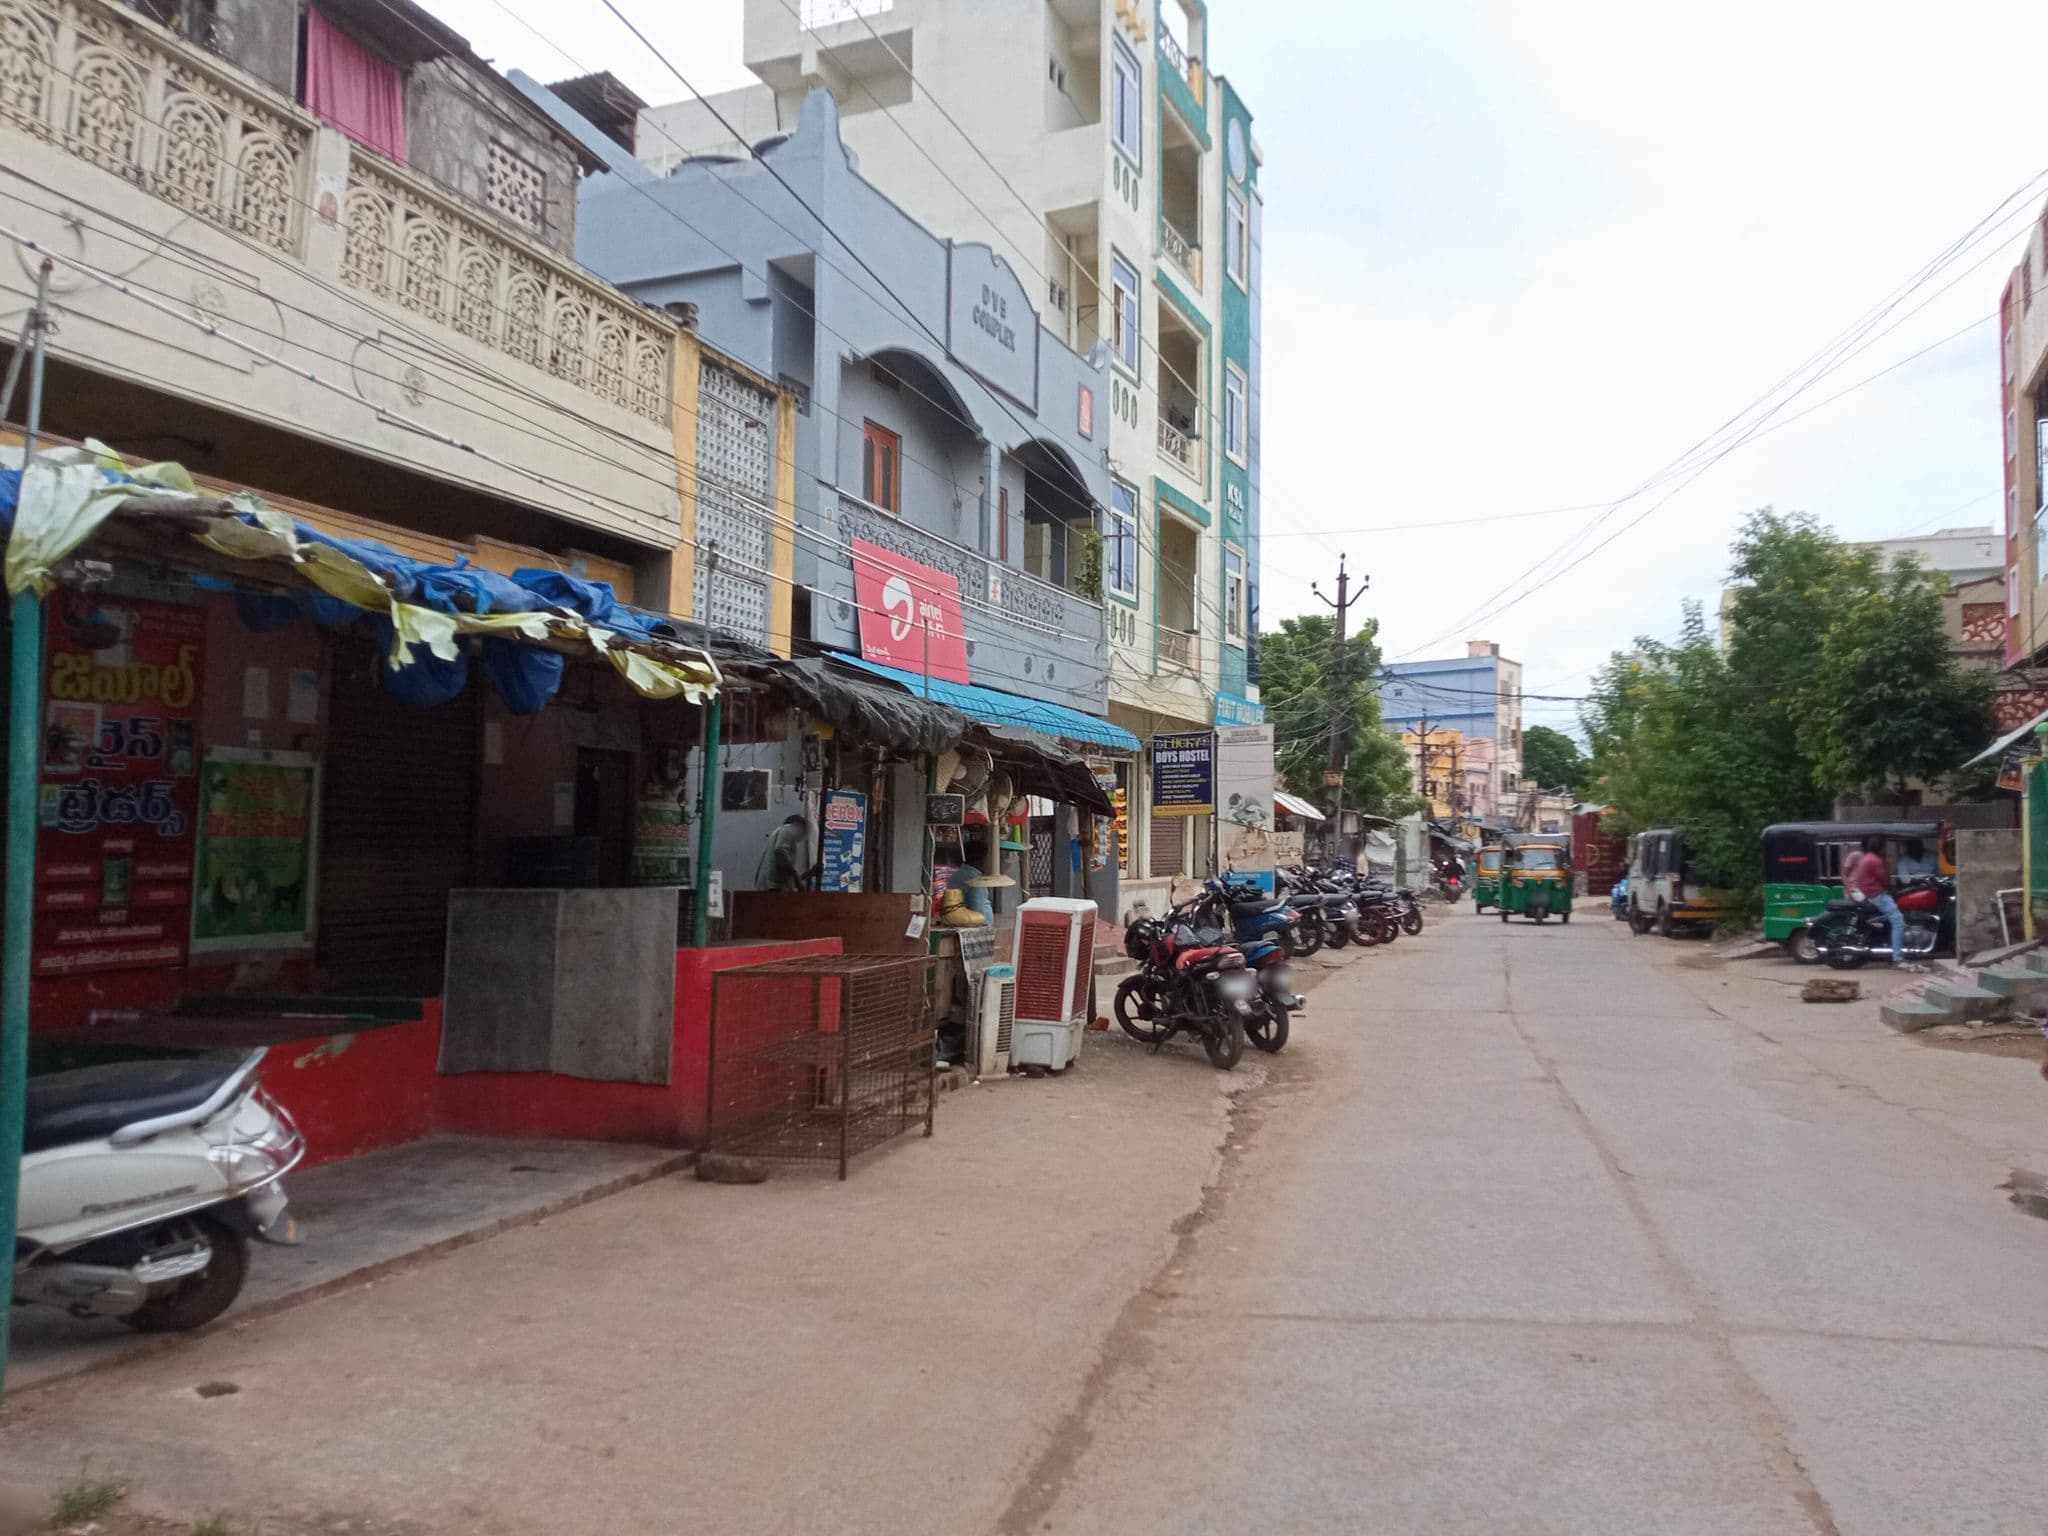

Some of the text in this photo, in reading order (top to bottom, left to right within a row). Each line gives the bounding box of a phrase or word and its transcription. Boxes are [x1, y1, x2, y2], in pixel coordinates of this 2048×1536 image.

[920, 598, 943, 621] airtel
[1155, 749, 1209, 763] BOYS HOSTEL
